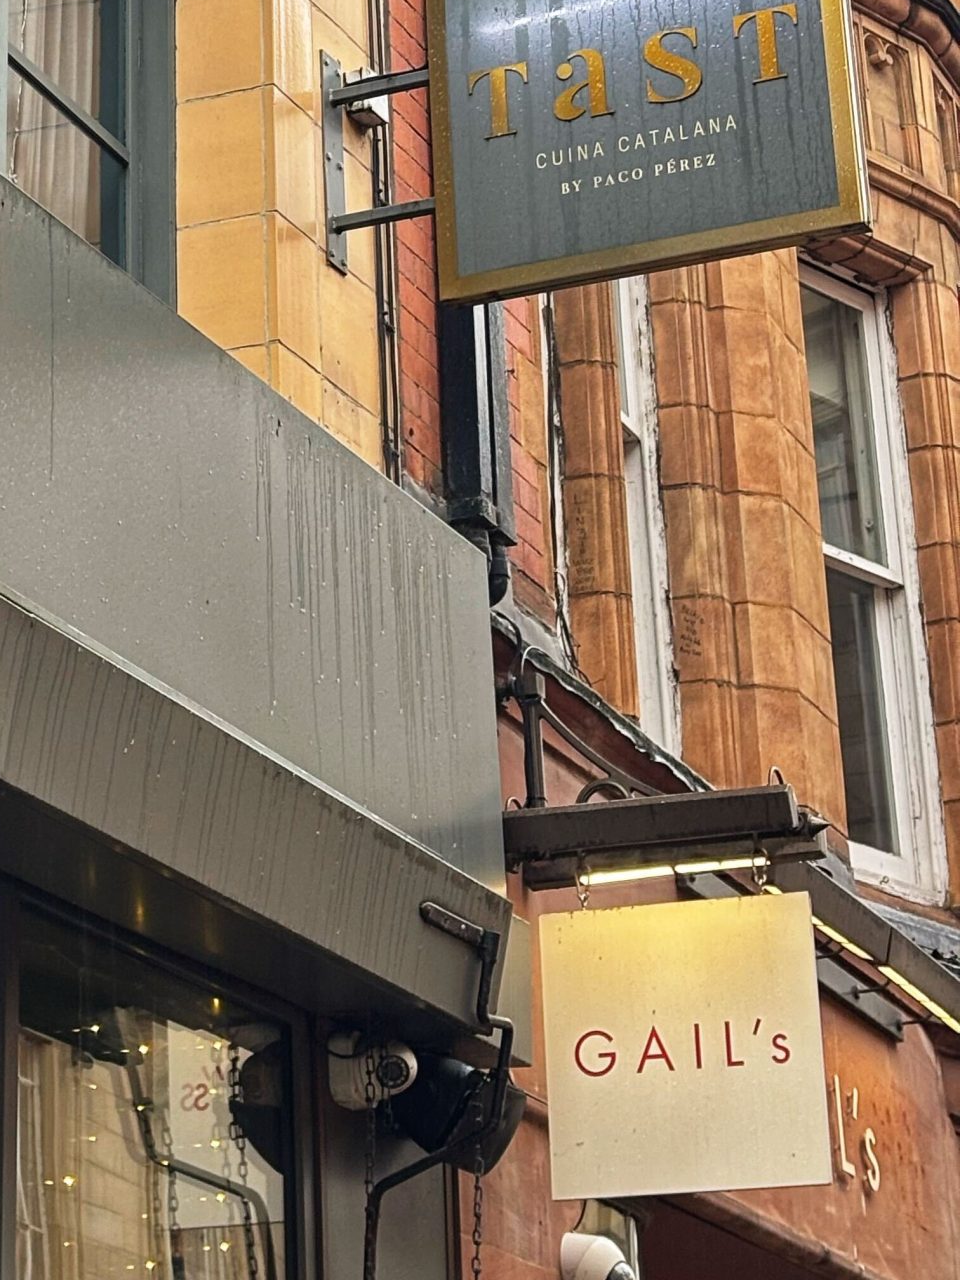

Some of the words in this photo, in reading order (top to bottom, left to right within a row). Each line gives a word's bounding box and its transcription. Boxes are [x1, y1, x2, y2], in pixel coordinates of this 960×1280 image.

[536, 142, 604, 169] CUINA
[618, 115, 737, 152] CATALANA
[561, 179, 582, 194] BY
[594, 168, 643, 188] PACO
[654, 153, 716, 176] PÉREZ
